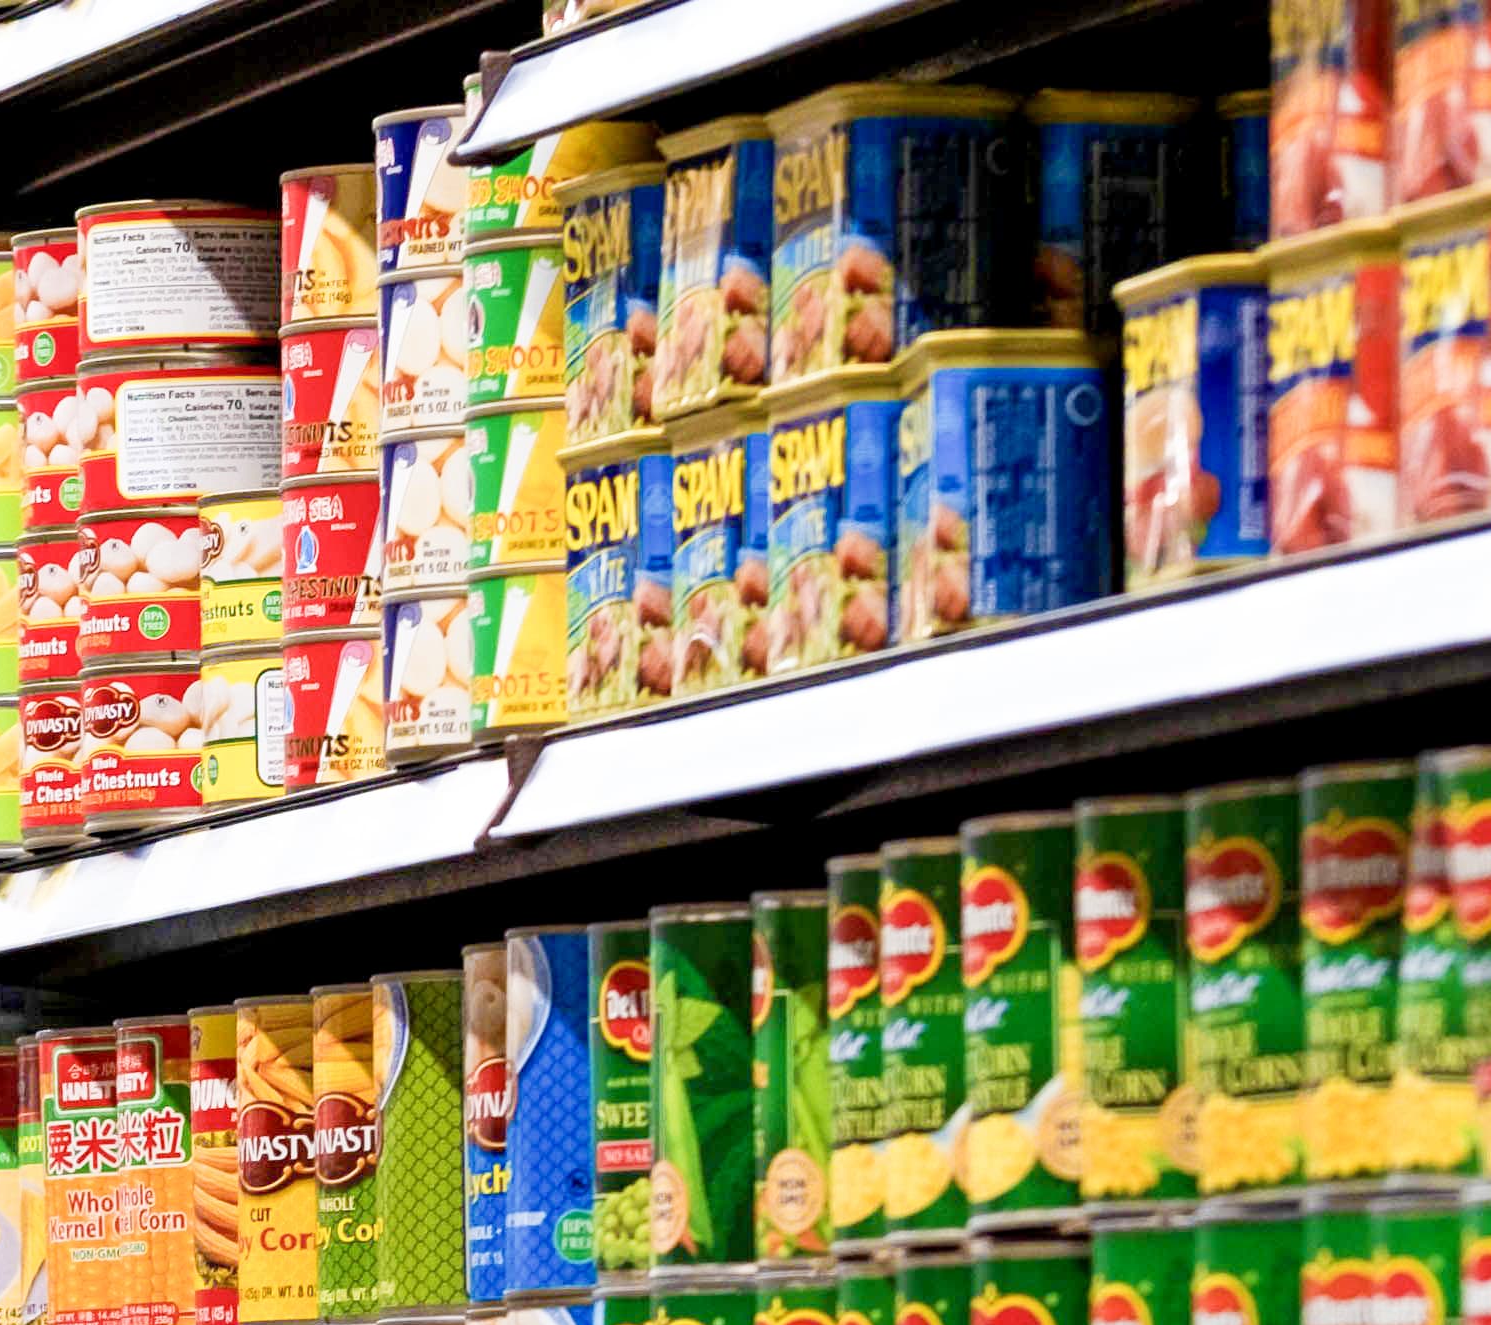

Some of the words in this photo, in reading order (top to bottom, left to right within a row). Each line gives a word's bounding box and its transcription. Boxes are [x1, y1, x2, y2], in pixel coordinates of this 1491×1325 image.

[185, 402, 225, 413] Calories
[770, 417, 846, 503] SPAM
[673, 449, 744, 531] SPAM
[567, 472, 639, 550] SPAM
[85, 702, 134, 723] DYNASTY
[25, 713, 81, 736] DYNASTY
[92, 757, 118, 770] Whole
[35, 769, 65, 783] Whole
[93, 769, 181, 792] Chestnuts
[37, 785, 81, 804] Chest
[596, 1101, 650, 1129] SWEE
[250, 1207, 271, 1223] CUT
